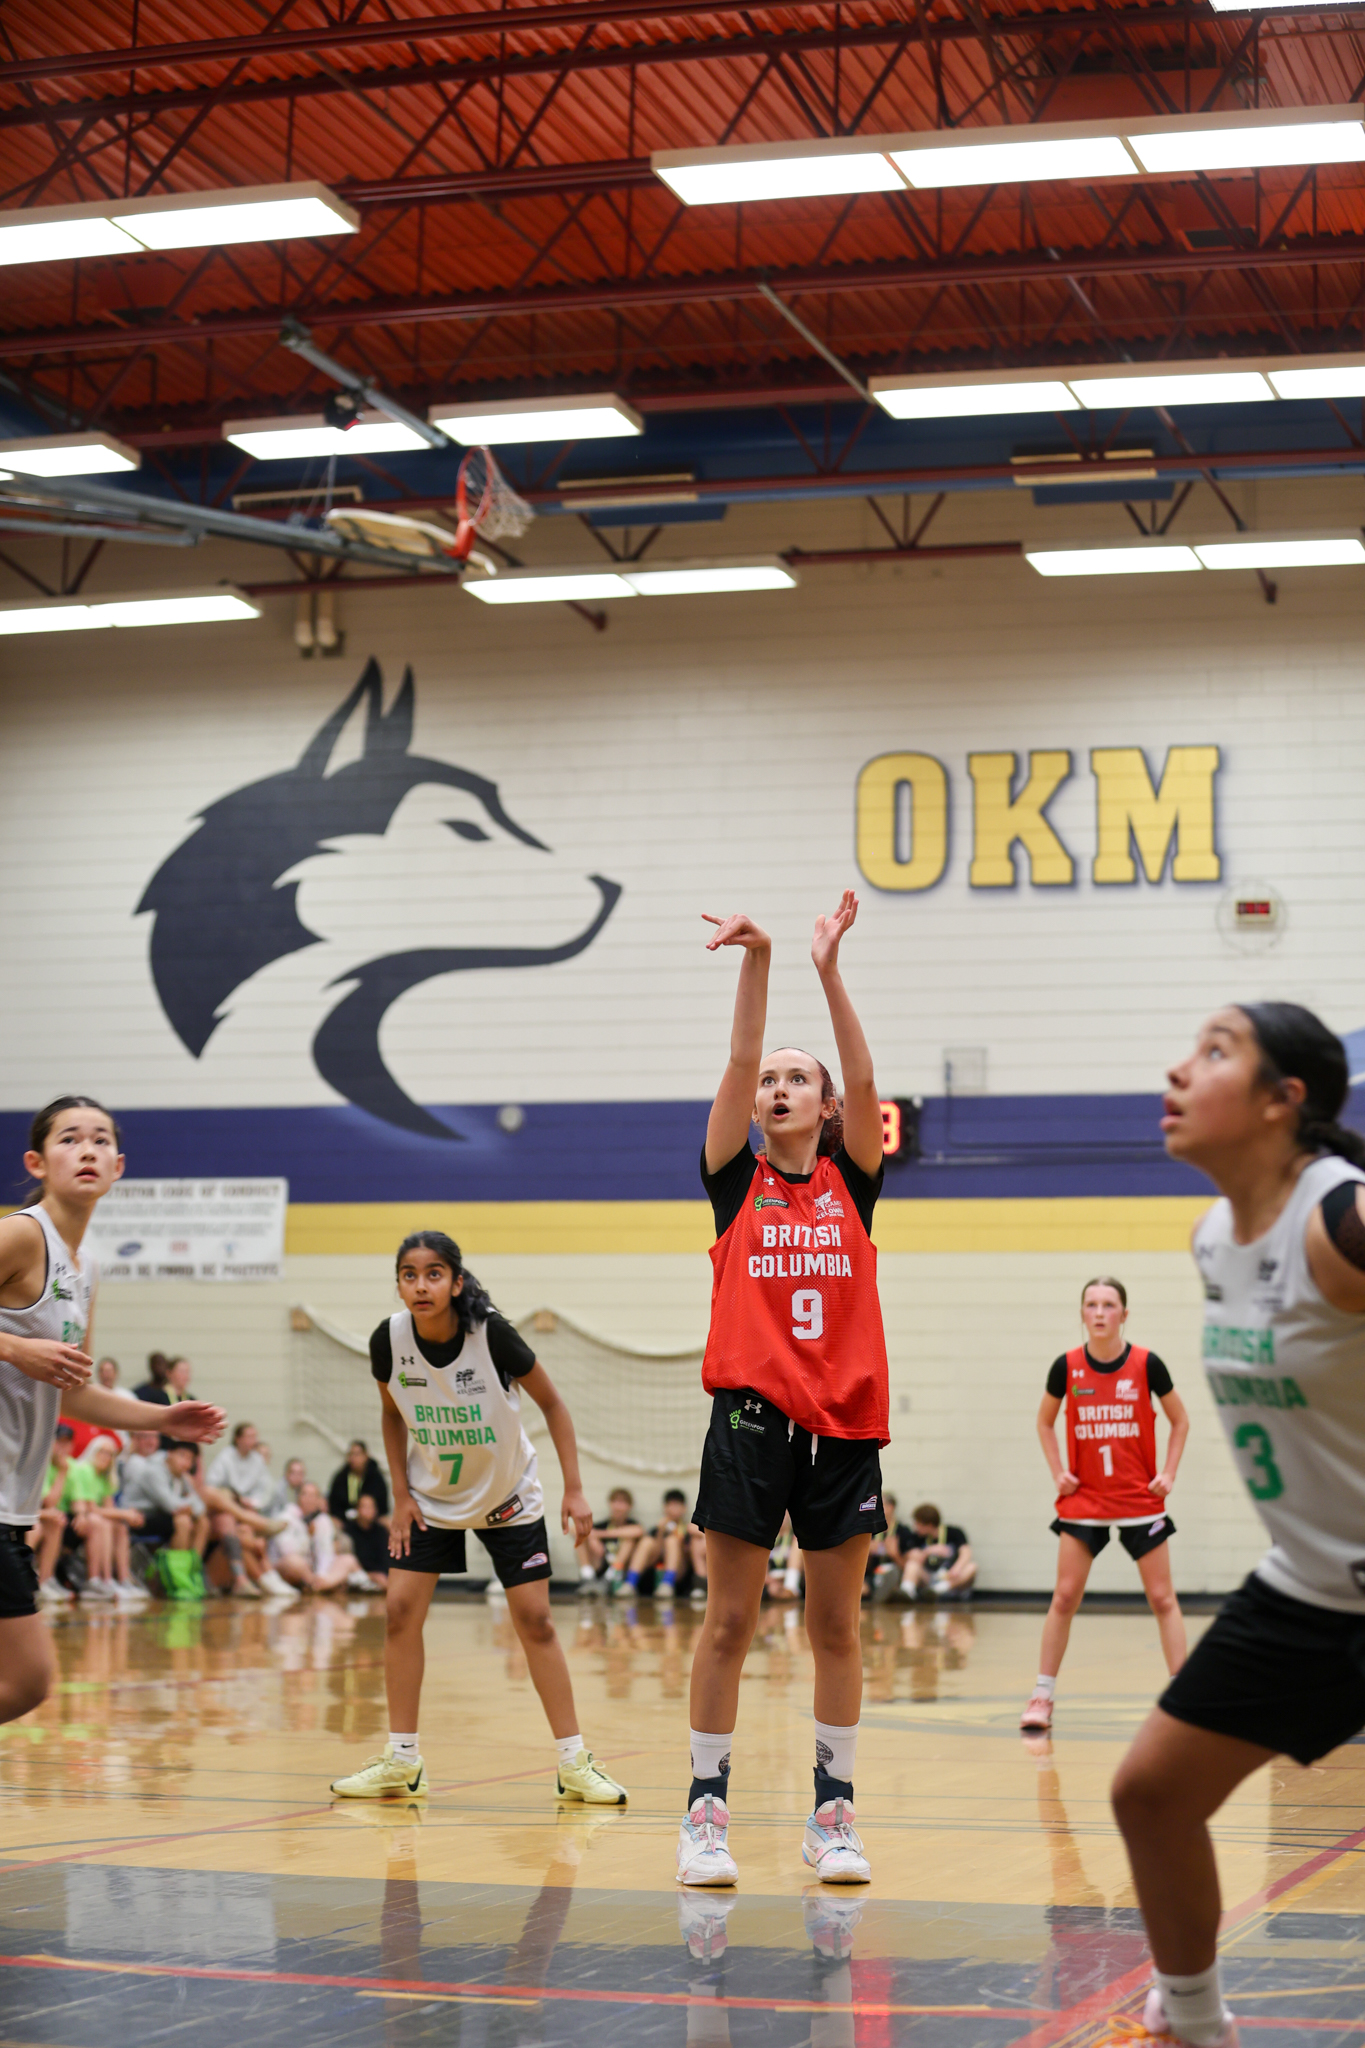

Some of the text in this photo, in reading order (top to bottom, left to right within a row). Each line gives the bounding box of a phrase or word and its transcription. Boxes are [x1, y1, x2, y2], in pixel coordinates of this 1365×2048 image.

[855, 745, 1222, 892] OKM
[762, 1224, 842, 1248] BRITISH
[748, 1253, 853, 1278] COLUMBIA
[791, 1288, 824, 1340] 9
[413, 1403, 483, 1424] BRITISH
[1077, 1404, 1135, 1422] BRITISH
[1074, 1422, 1141, 1440] COLUMBIA
[438, 1453, 464, 1486] 7
[1098, 1444, 1114, 1477] 1
[1233, 1422, 1285, 1501] 3
